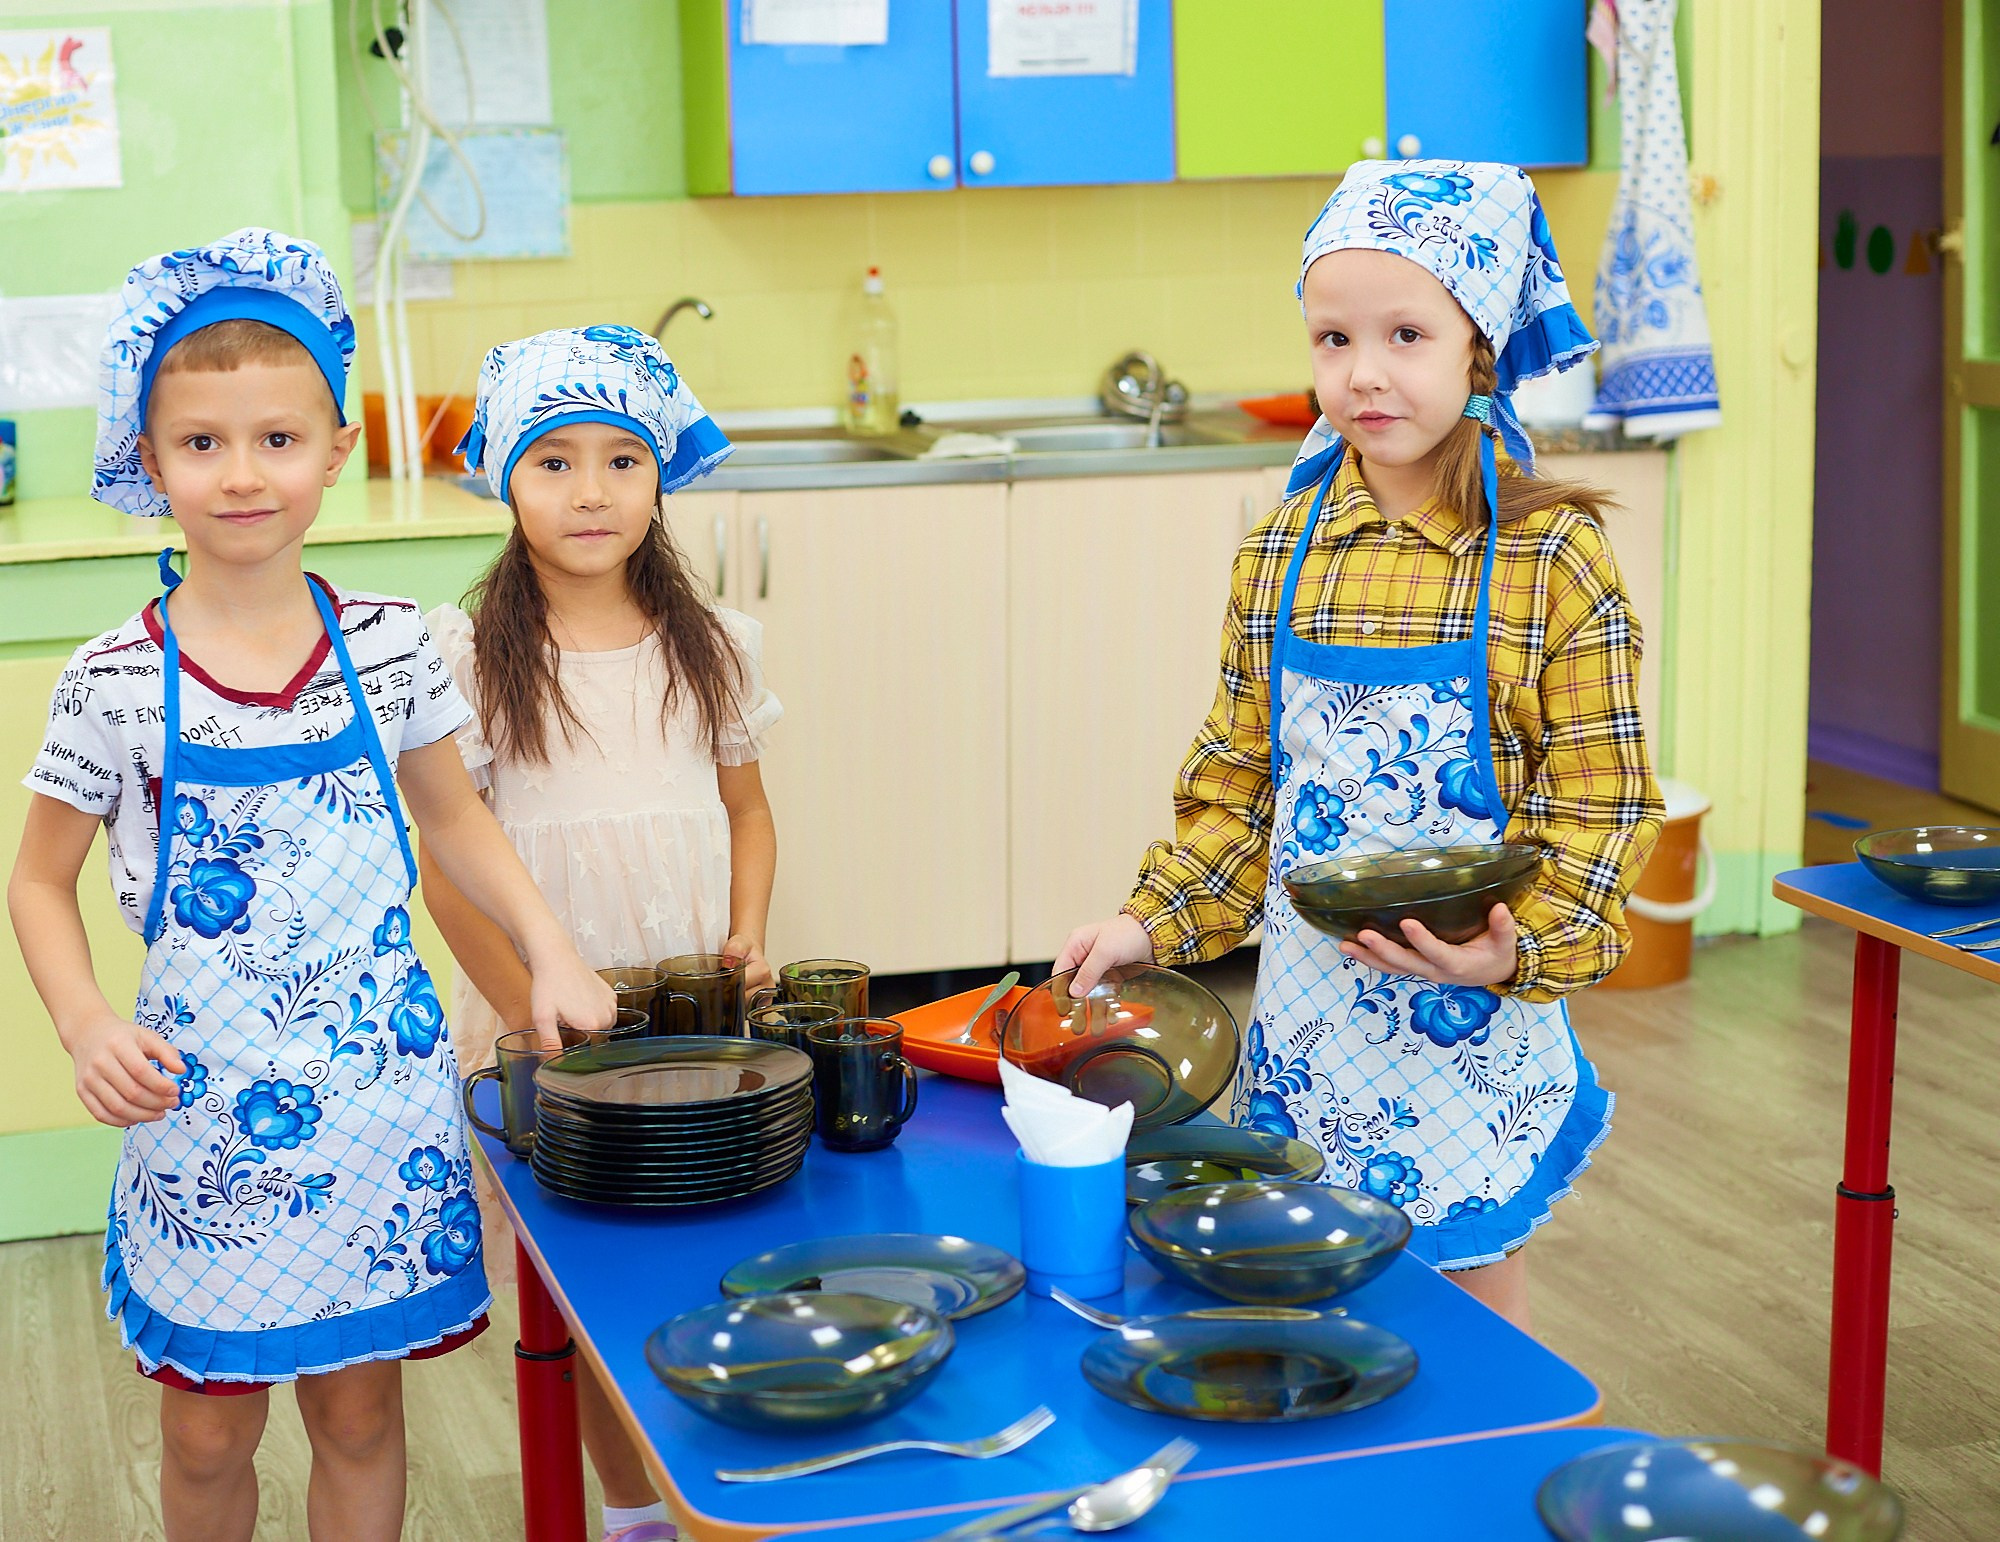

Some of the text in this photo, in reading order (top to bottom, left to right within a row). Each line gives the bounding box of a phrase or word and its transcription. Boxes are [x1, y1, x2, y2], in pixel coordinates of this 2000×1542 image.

[101, 705, 165, 727] THE END
[210, 725, 243, 749] EFT
[43, 741, 76, 763] WHAT
